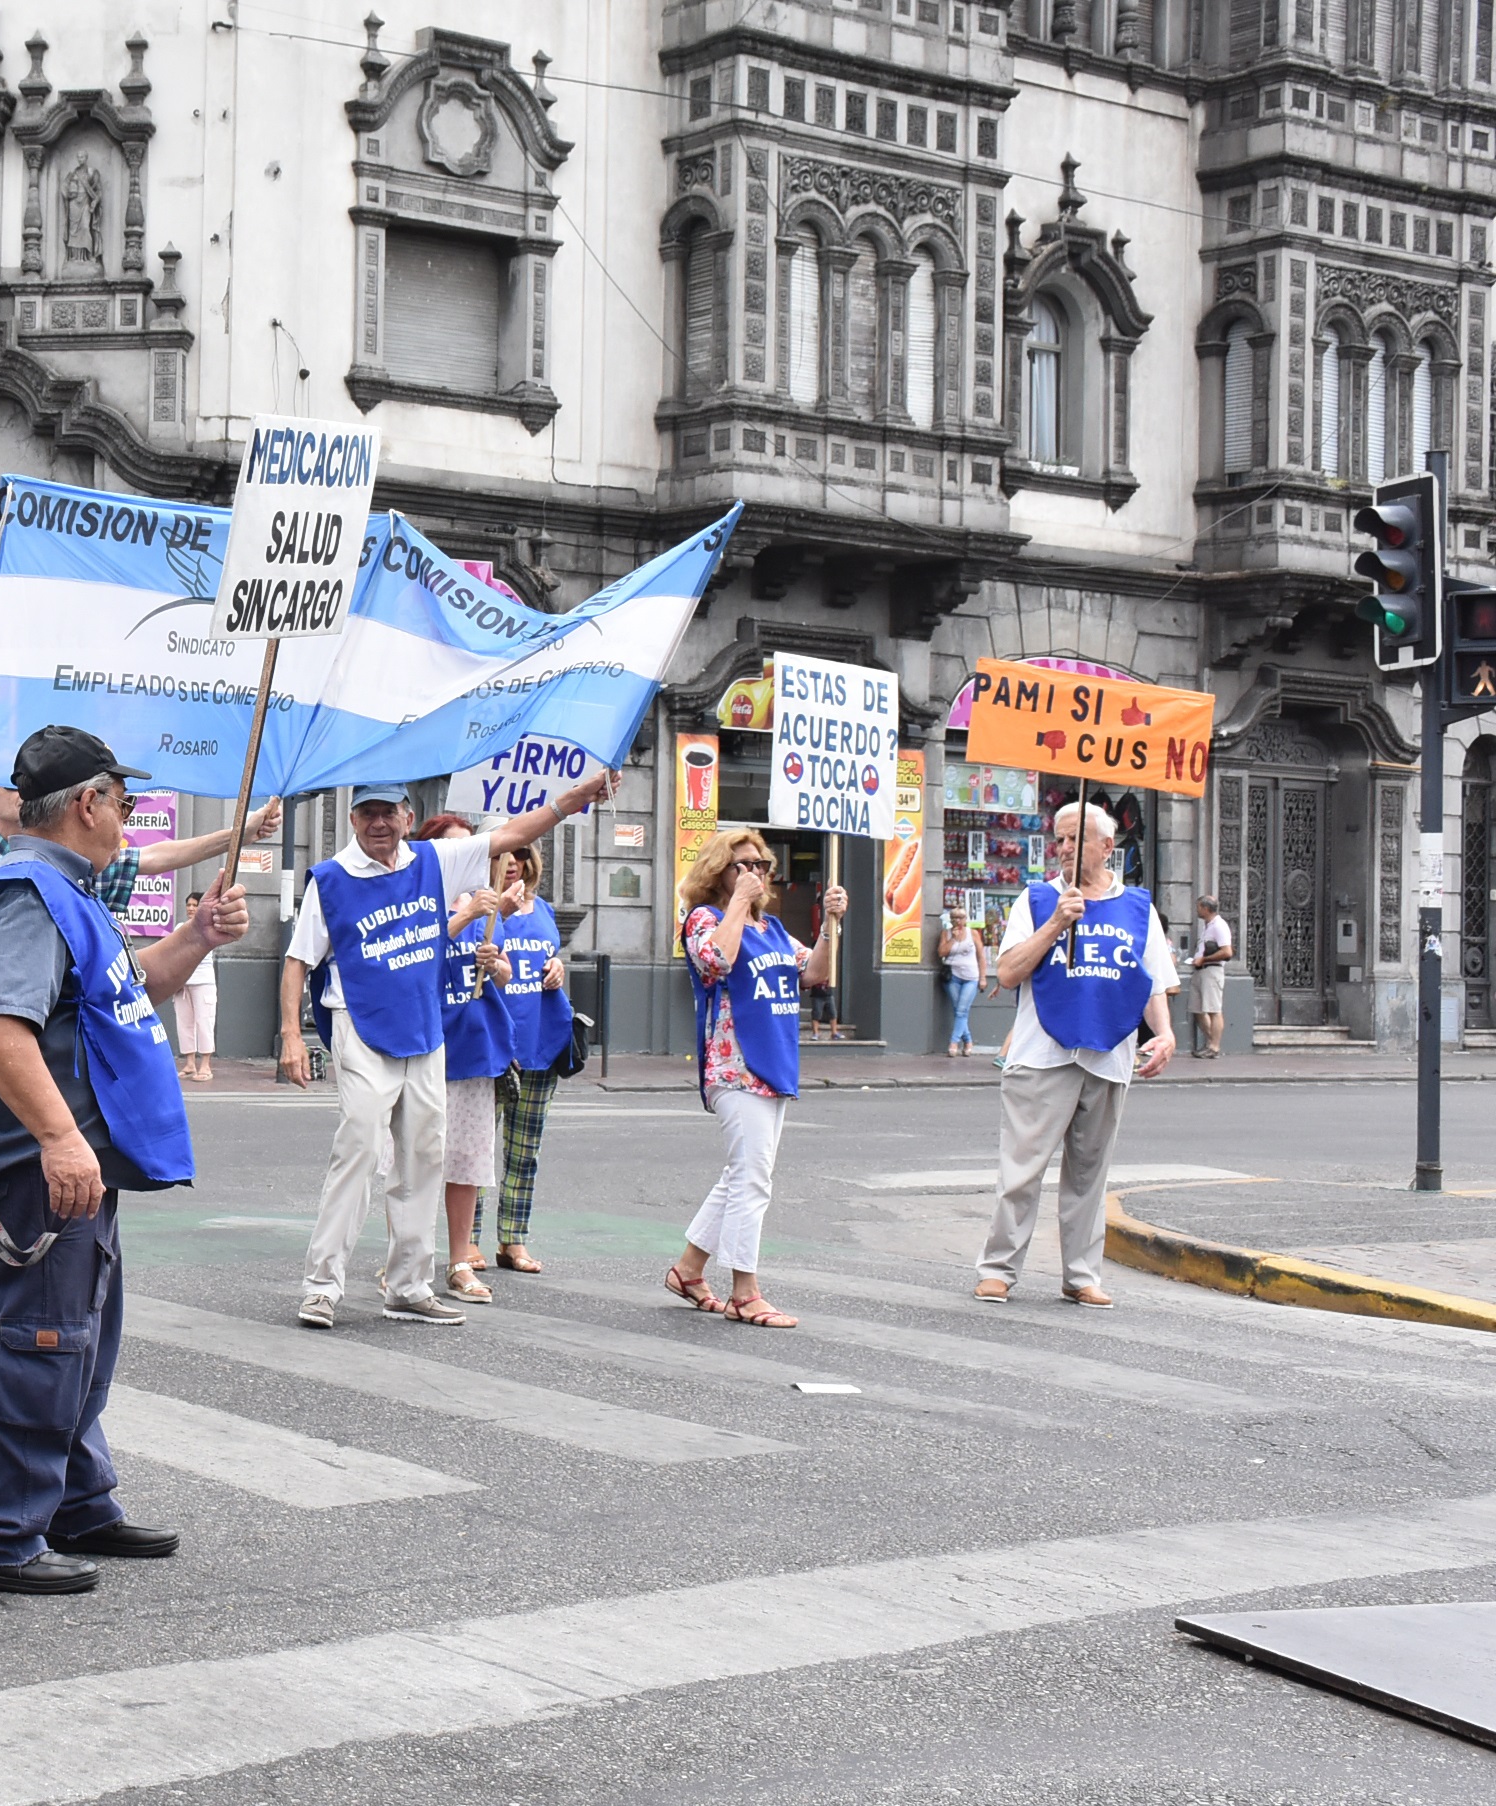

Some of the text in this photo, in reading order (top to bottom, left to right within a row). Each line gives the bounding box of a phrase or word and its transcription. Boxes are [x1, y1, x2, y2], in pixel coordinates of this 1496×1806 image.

[246, 427, 372, 488] MEDICACION
[168, 514, 214, 552] DE
[266, 511, 343, 566] SALUD
[383, 535, 529, 640] COMISION
[167, 630, 236, 657] SINDICATO
[191, 682, 210, 703] DE
[781, 664, 888, 715] ESTAS DE
[972, 672, 1104, 725] PAMI SI
[157, 733, 219, 756] ROSARIO
[778, 712, 881, 758] ACUERDO
[807, 754, 859, 793] TOCA
[1076, 733, 1208, 783] CUS NO
[680, 818, 716, 830] Gaseosa
[681, 807, 715, 819] Vaso de
[356, 895, 437, 940] JUBILADOS
[361, 932, 405, 962] Empleados
[405, 927, 415, 945] de
[388, 947, 435, 971] ROSARIO
[1084, 943, 1107, 963] E.
[1113, 945, 1138, 968] C.
[753, 976, 794, 1000] A. E.
[1066, 965, 1121, 980] ROSARIO
